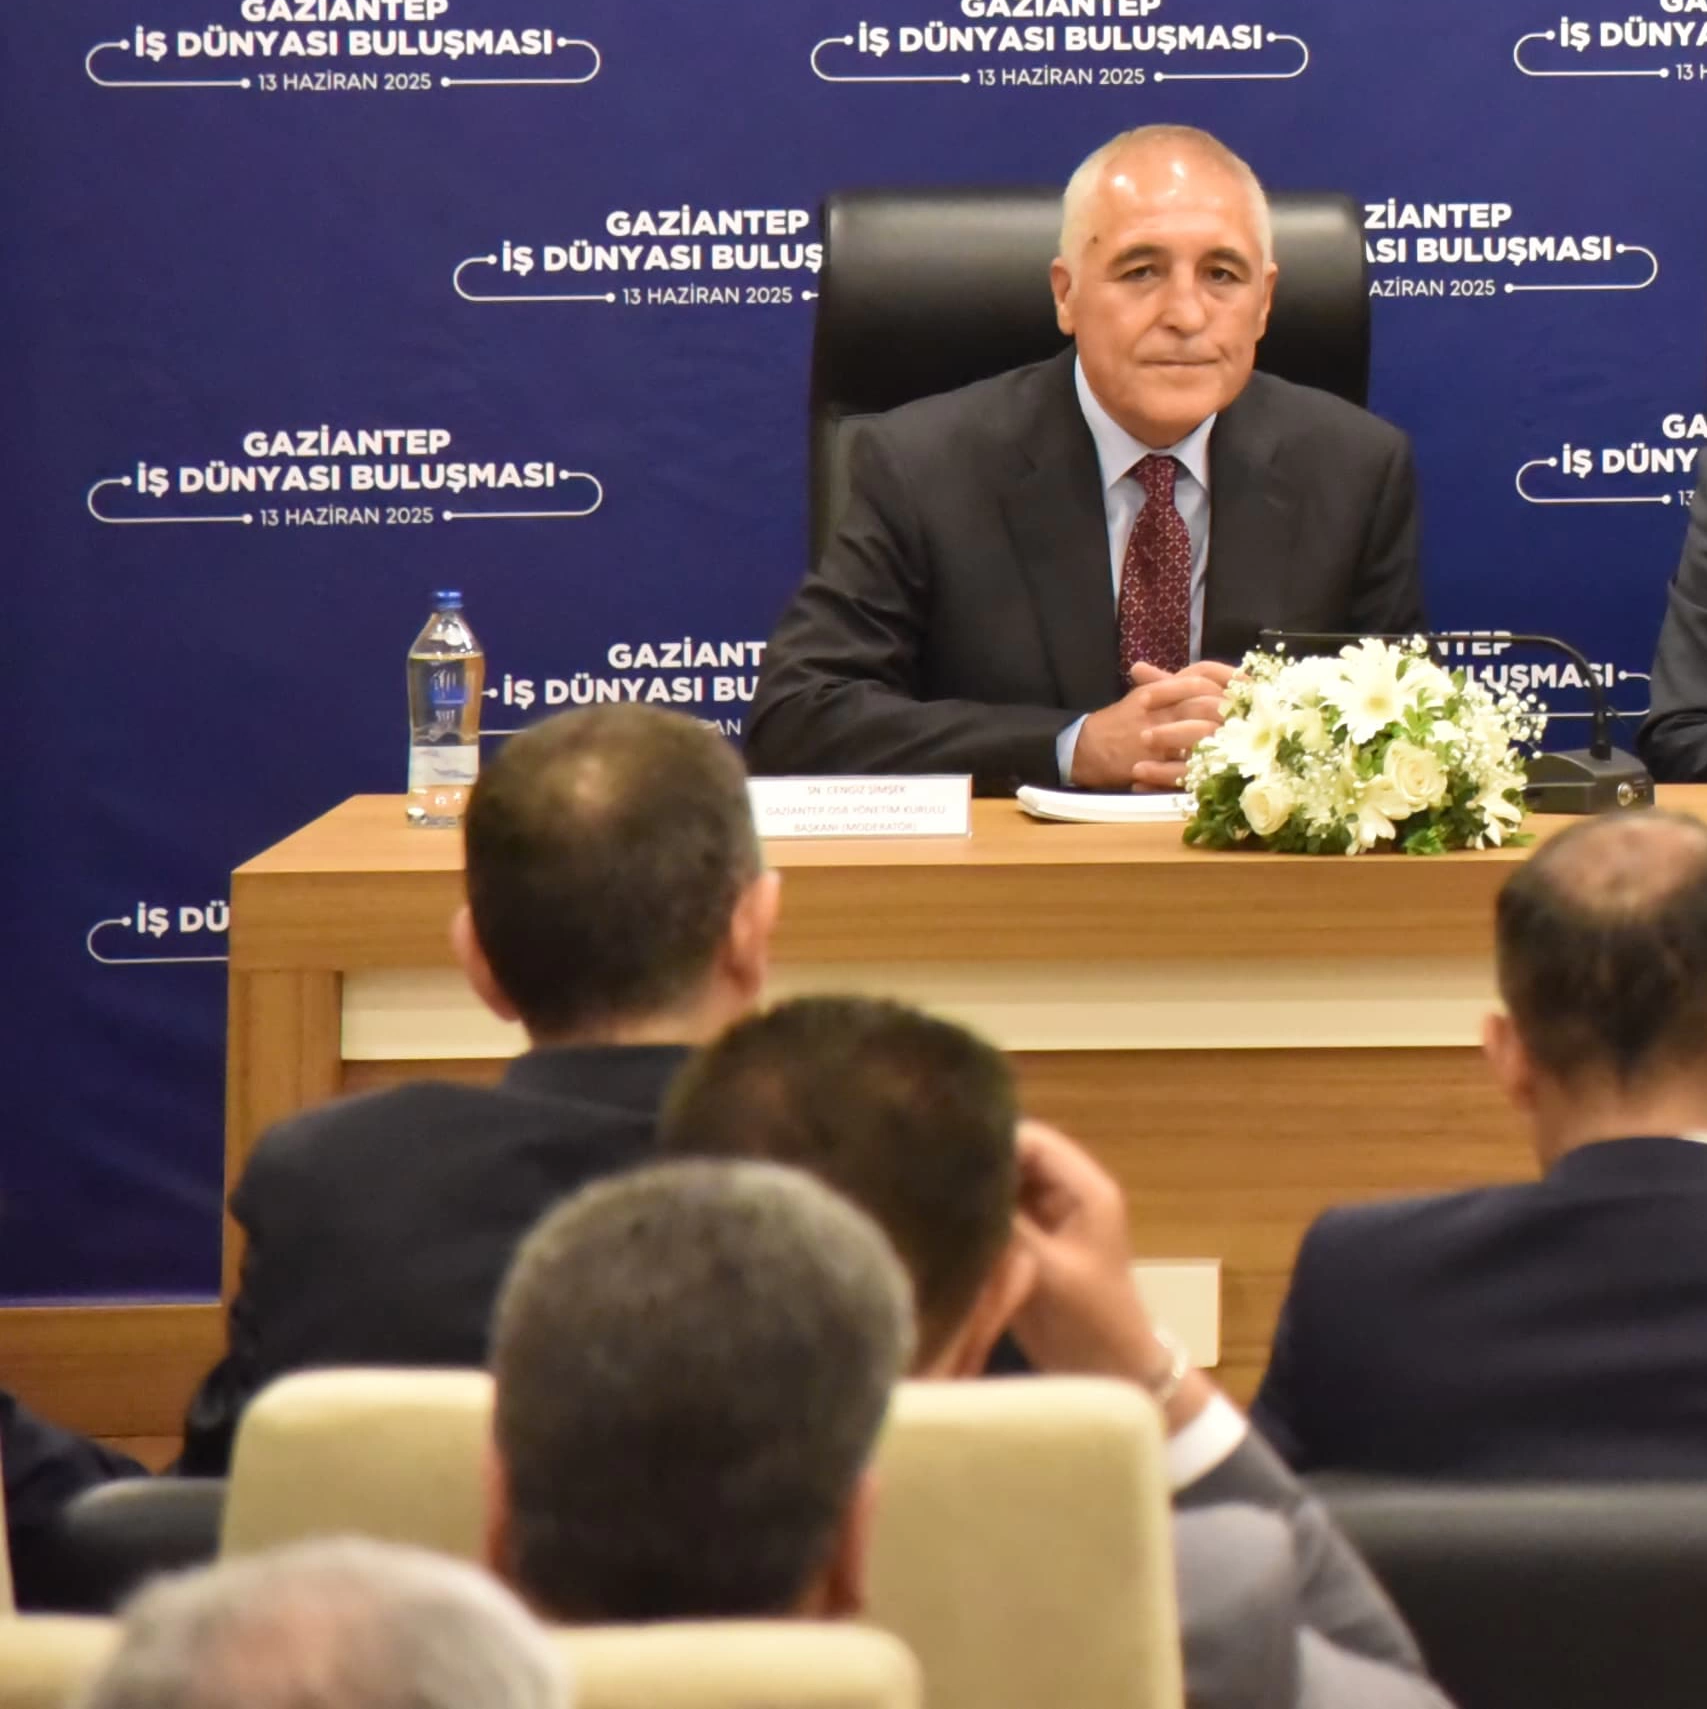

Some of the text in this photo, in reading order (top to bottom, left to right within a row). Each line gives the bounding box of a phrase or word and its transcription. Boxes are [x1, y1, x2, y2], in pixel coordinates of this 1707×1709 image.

[135, 24, 553, 63] İŞ DÜNYASI BULUŞMASI
[858, 20, 1263, 58] İŞ DÜNYASI BULUŞMASI
[1559, 15, 1592, 53] İŞ
[258, 69, 432, 92] 13 HAZİRAN 2025
[977, 64, 1146, 86] 13 HAZİRAN 2025
[1675, 63, 1695, 81] 13
[605, 203, 810, 237] GAZİANTEP
[1363, 197, 1513, 230] ZİANTEP
[502, 239, 823, 277] İŞ DÜNYASI BULUŞ
[1416, 235, 1612, 267] BULUŞMASI
[622, 283, 793, 305] 13 HAZİRAN 2025
[1368, 275, 1496, 297] AZİRAN 2025
[242, 424, 452, 458] GAZİANTEP
[1562, 442, 1699, 479] İŞ DÜNY
[137, 460, 555, 498] İŞ DÜNYASI BULUŞMASI
[260, 504, 434, 526] 13 HAZİRAN 2025
[607, 636, 768, 669] GAZİANT
[503, 673, 536, 710] İŞ
[545, 672, 704, 704] DÜNYASI
[136, 900, 170, 939] İŞ
